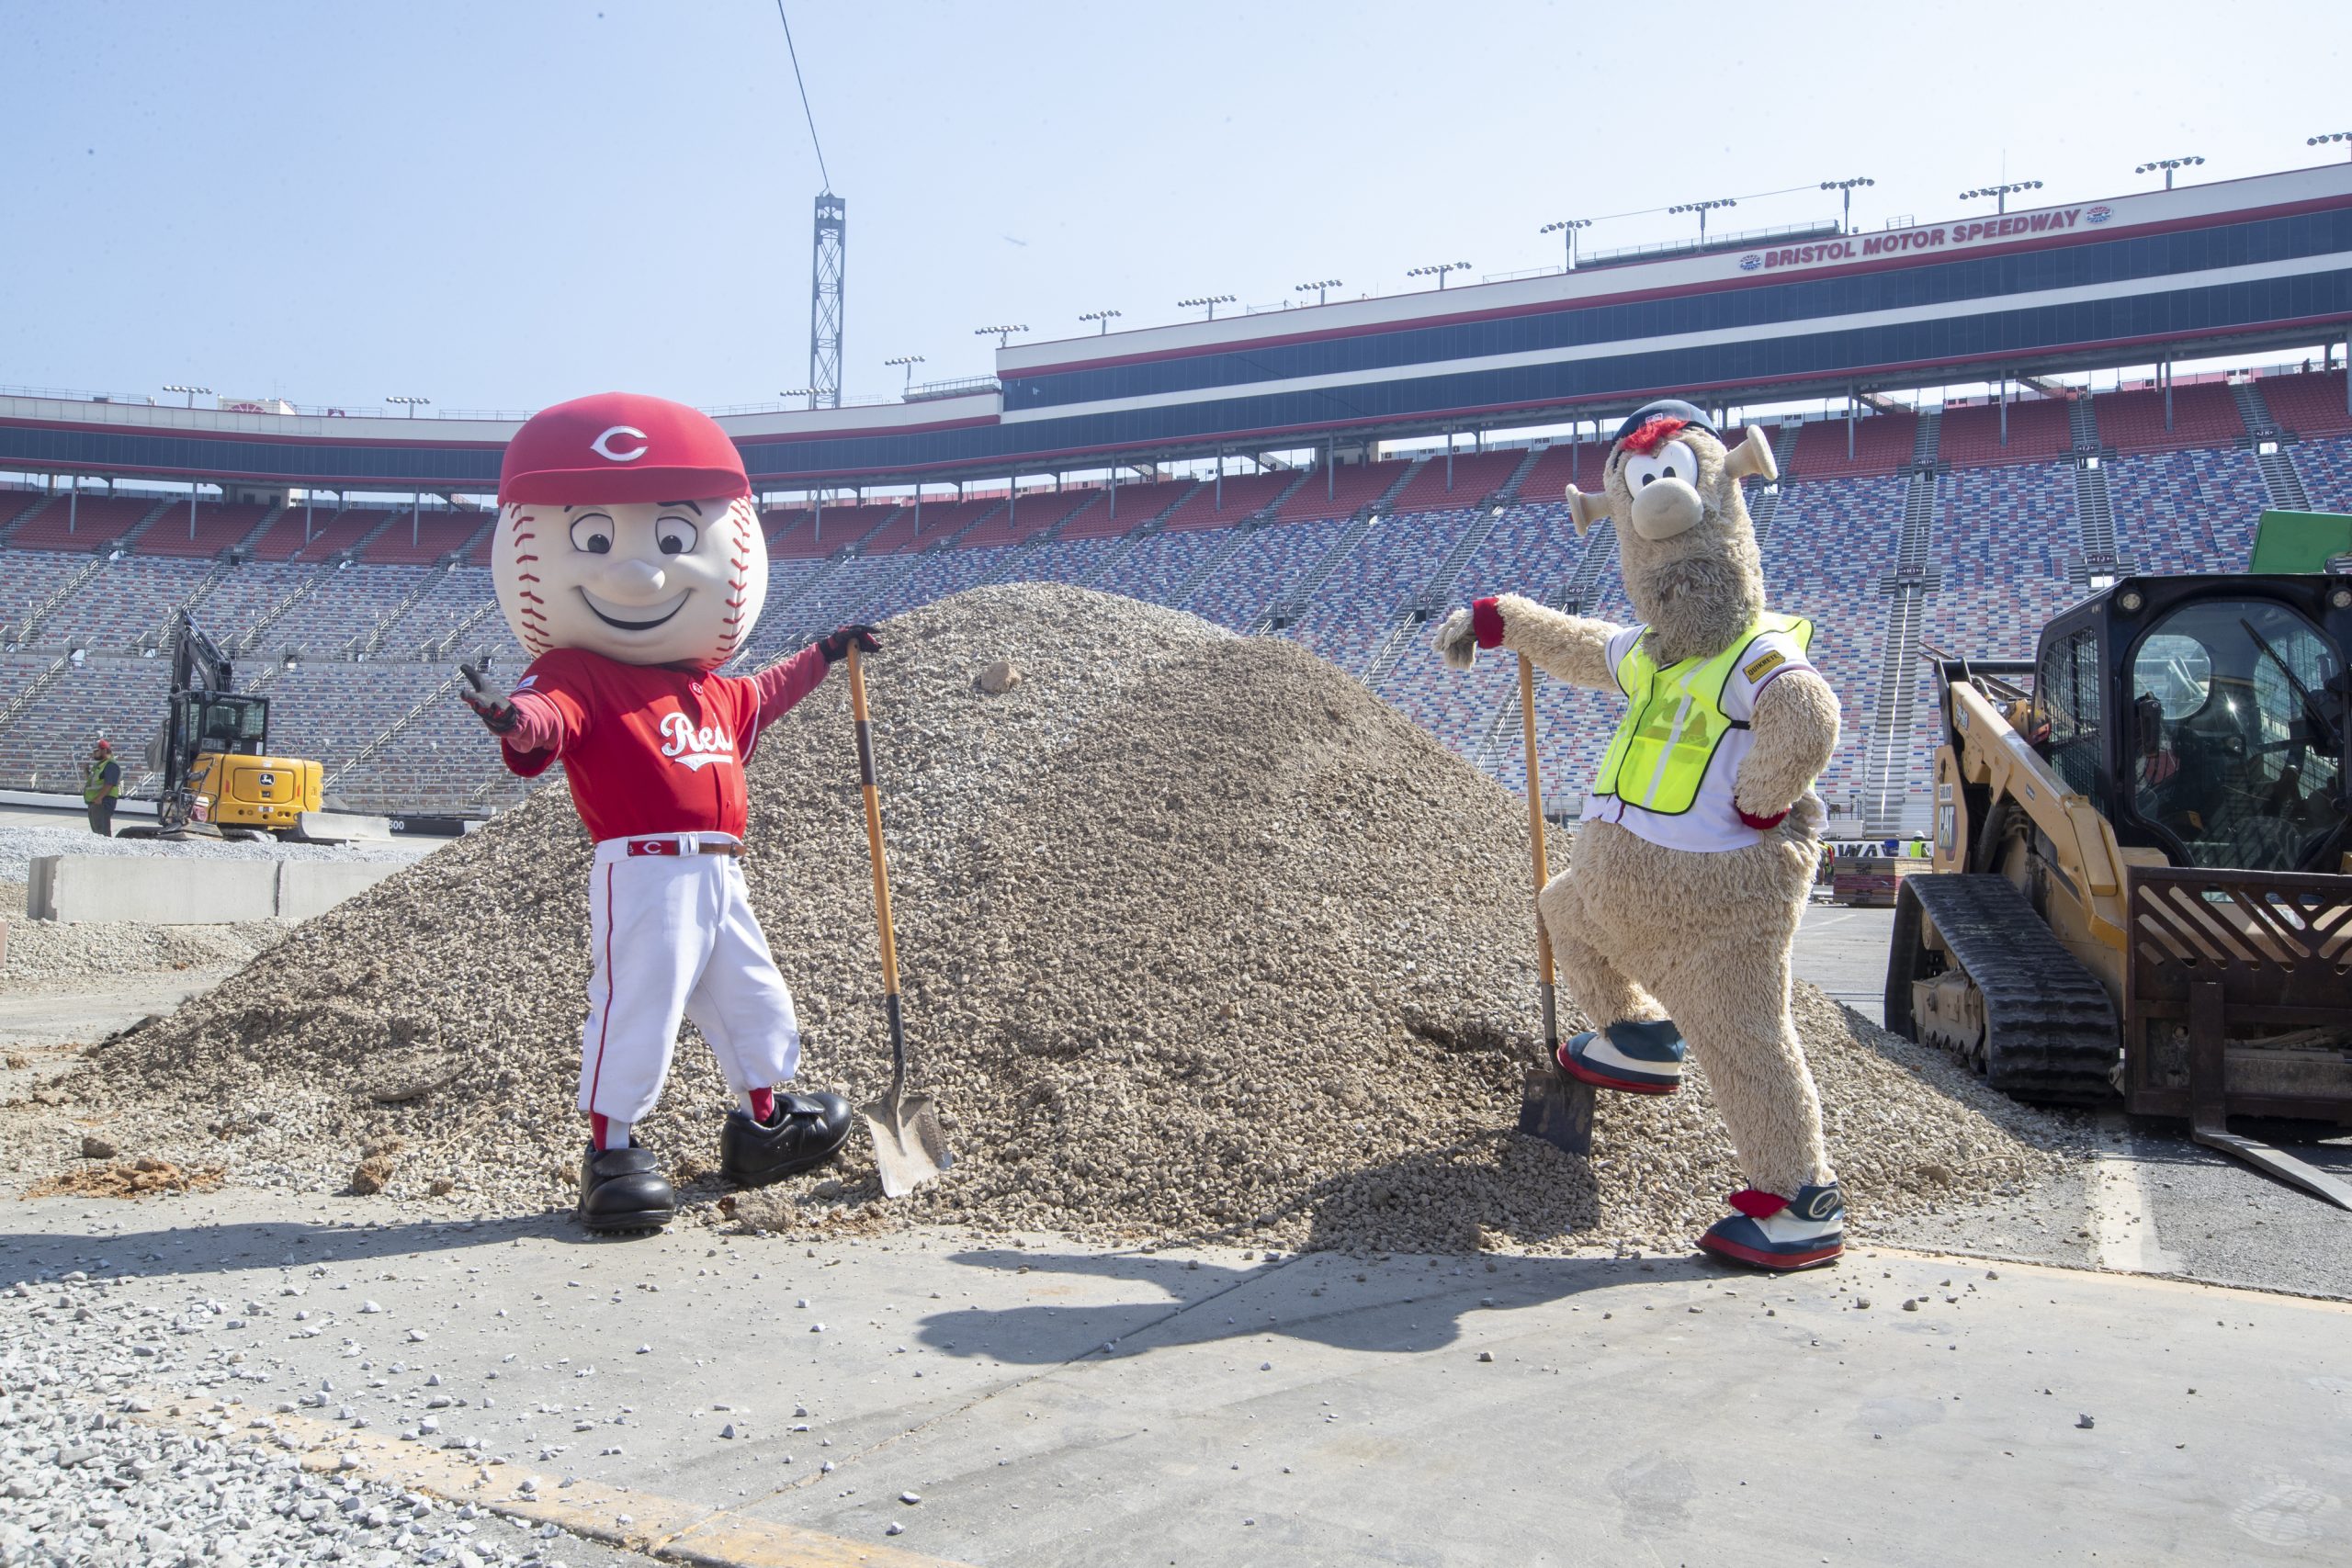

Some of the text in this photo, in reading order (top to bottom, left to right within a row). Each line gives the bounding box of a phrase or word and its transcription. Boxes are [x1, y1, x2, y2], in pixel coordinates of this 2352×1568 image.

[1764, 209, 2082, 269] BRISTOL MOTOR SPEEDWAY
[590, 425, 649, 462] C
[1747, 653, 1781, 676] QUIKRETE
[1939, 806, 1954, 847] CAT
